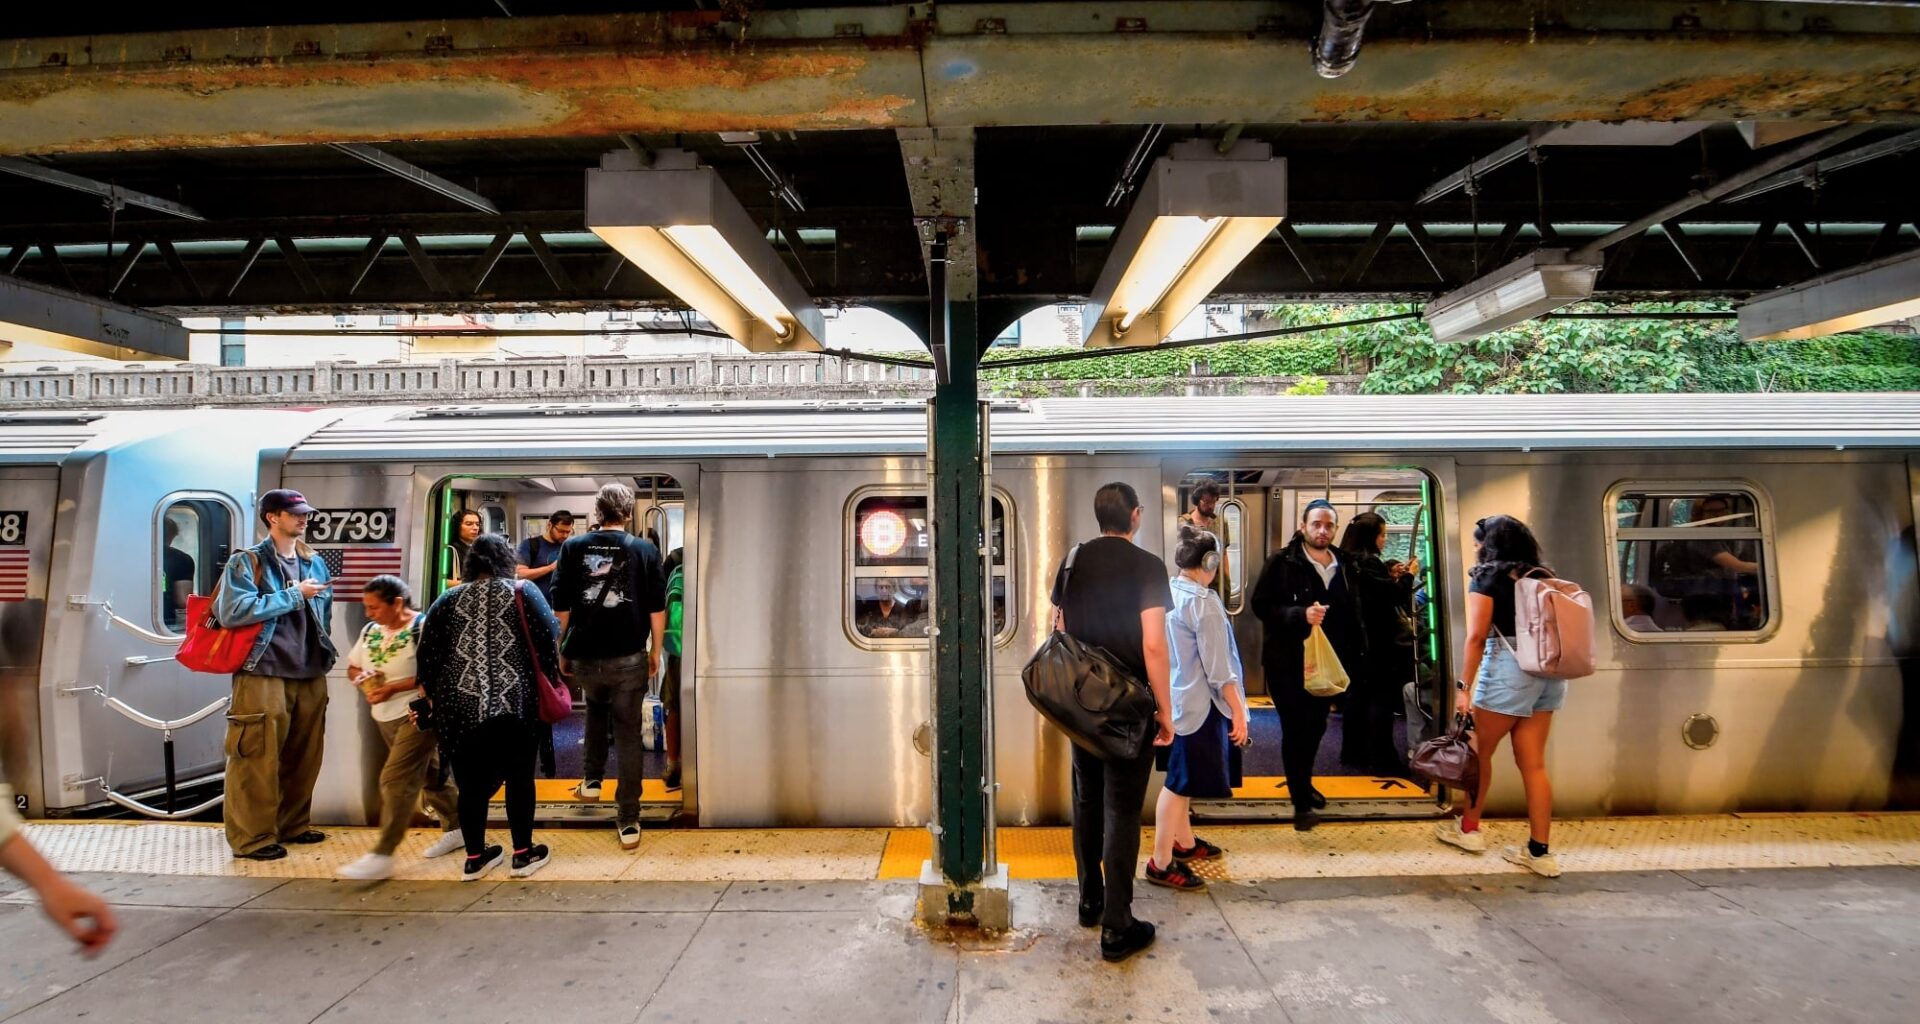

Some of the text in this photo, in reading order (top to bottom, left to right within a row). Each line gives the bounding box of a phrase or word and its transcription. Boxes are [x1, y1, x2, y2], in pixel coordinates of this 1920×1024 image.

[0, 514, 20, 542] 8
[312, 511, 388, 540] 3739
[17, 795, 27, 809] 2
